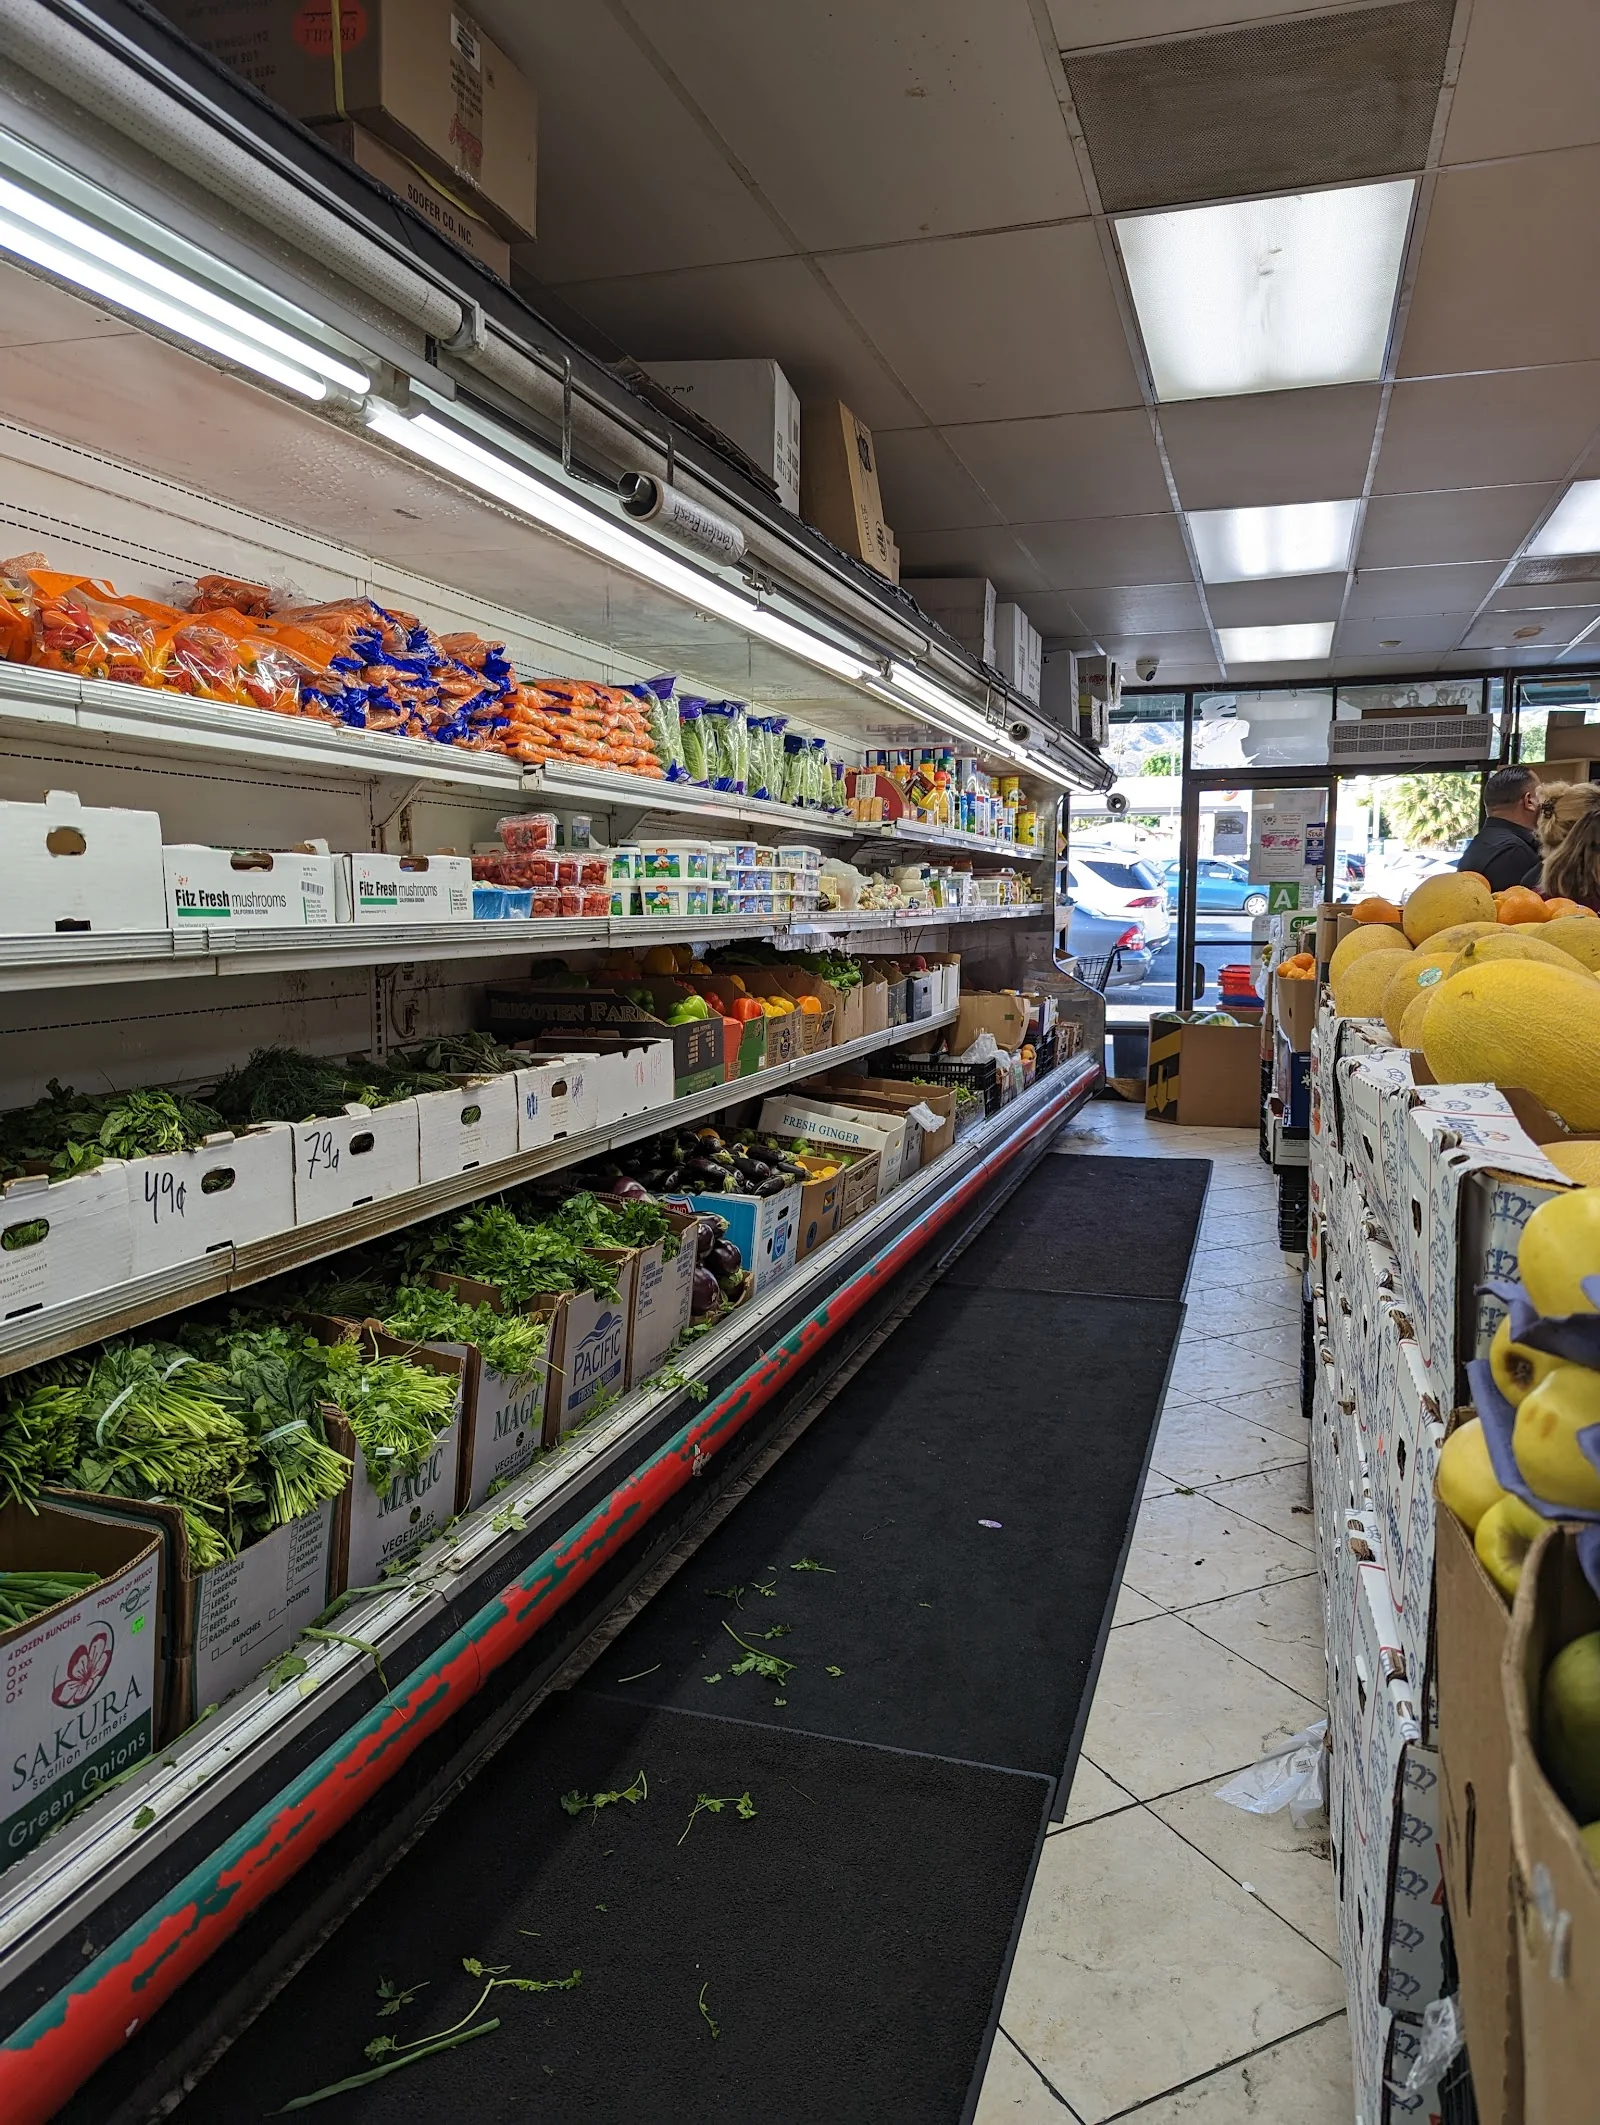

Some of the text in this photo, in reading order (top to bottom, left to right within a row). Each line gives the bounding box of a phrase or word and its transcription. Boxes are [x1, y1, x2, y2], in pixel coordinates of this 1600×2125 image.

[407, 183, 474, 248] SOOFER CO. INC.
[673, 504, 700, 533] Fresh
[703, 522, 734, 551] Garden
[175, 889, 287, 908] Fitz Fresh mushrooms
[359, 881, 438, 897] Fitz Fresh mushrooms
[1273, 889, 1293, 909] A
[590, 1002, 658, 1023] FARM
[783, 1114, 859, 1145] FRESH GINGER
[145, 1171, 187, 1224] 49¢
[0, 1274, 19, 1284] ERSIAN
[573, 1330, 621, 1387] PACIFIC
[493, 1383, 543, 1442] MAGIC
[494, 1437, 535, 1473] VEGETABLES
[377, 1447, 443, 1519] MAGIC
[298, 1514, 322, 1533] DAIKON
[298, 1522, 324, 1543] CABBAGE
[382, 1510, 435, 1555] VEGETABLES
[296, 1541, 323, 1563] ROMAINE
[297, 1535, 318, 1553] LETTUCE
[213, 1561, 245, 1587] ESCAROLE
[214, 1559, 236, 1575] ENDIV
[295, 1554, 319, 1574] TURNIPS
[97, 1566, 153, 1609] PRODUCT OF MEXICO
[211, 1592, 229, 1609] LEEKS
[212, 1577, 237, 1598] GREENS
[286, 1586, 310, 1607] DOZENS
[210, 1597, 238, 1620] PARSLEY
[209, 1615, 227, 1632] BEETS
[209, 1617, 240, 1644] RADISHES
[232, 1620, 261, 1646] BUNCHES
[7, 1613, 81, 1661] 4 DOZEN BUNCHES
[12, 1674, 143, 1792] SAKURA
[32, 1712, 128, 1791] Scallion Farmers
[8, 1731, 146, 1848] Green Onions
